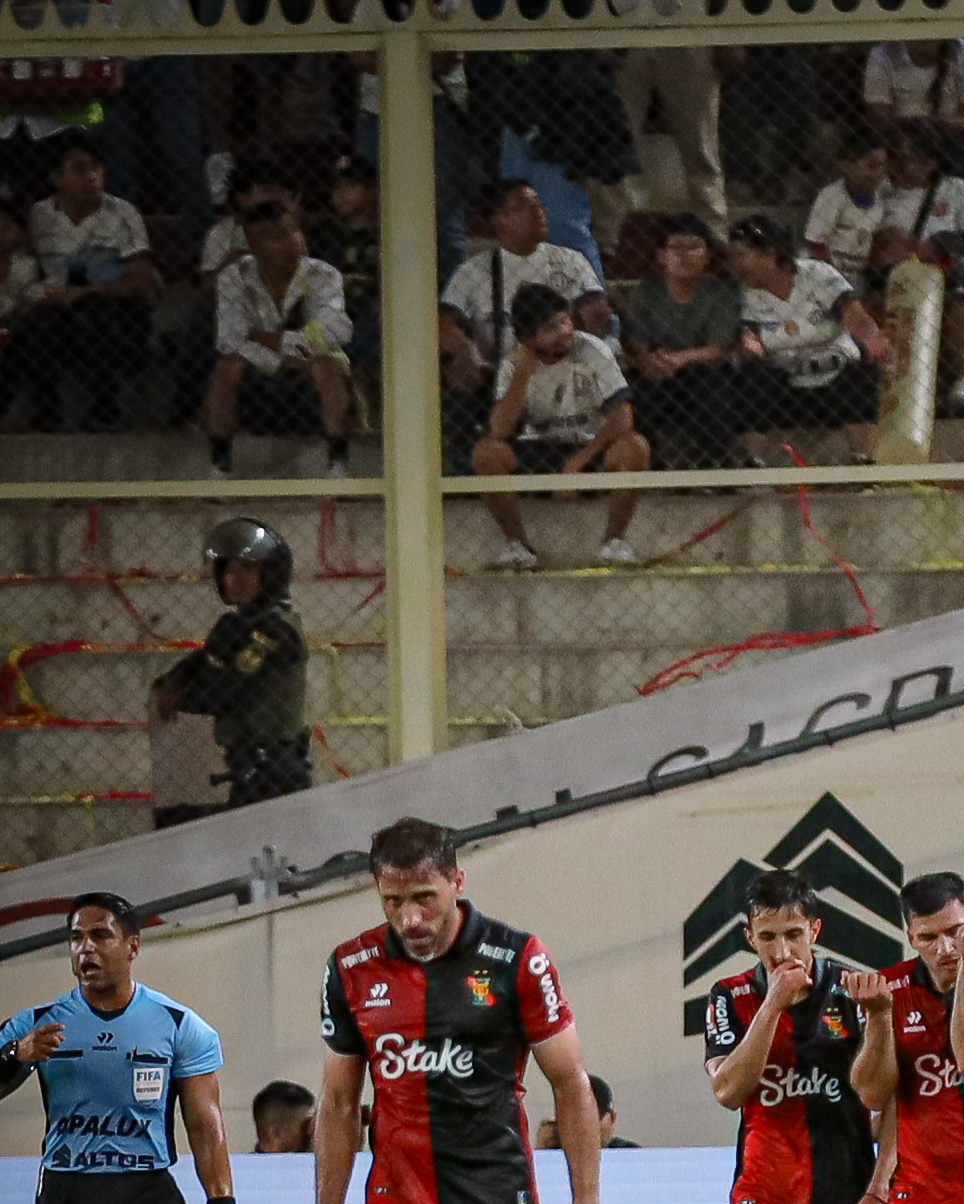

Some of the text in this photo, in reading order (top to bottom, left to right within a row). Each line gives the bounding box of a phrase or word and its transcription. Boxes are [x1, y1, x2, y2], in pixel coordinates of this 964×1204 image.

[375, 1032, 474, 1079] Stake
[136, 1071, 161, 1081] FIFA
[759, 1064, 842, 1107] Stake
[74, 1149, 155, 1170] ALTOS
